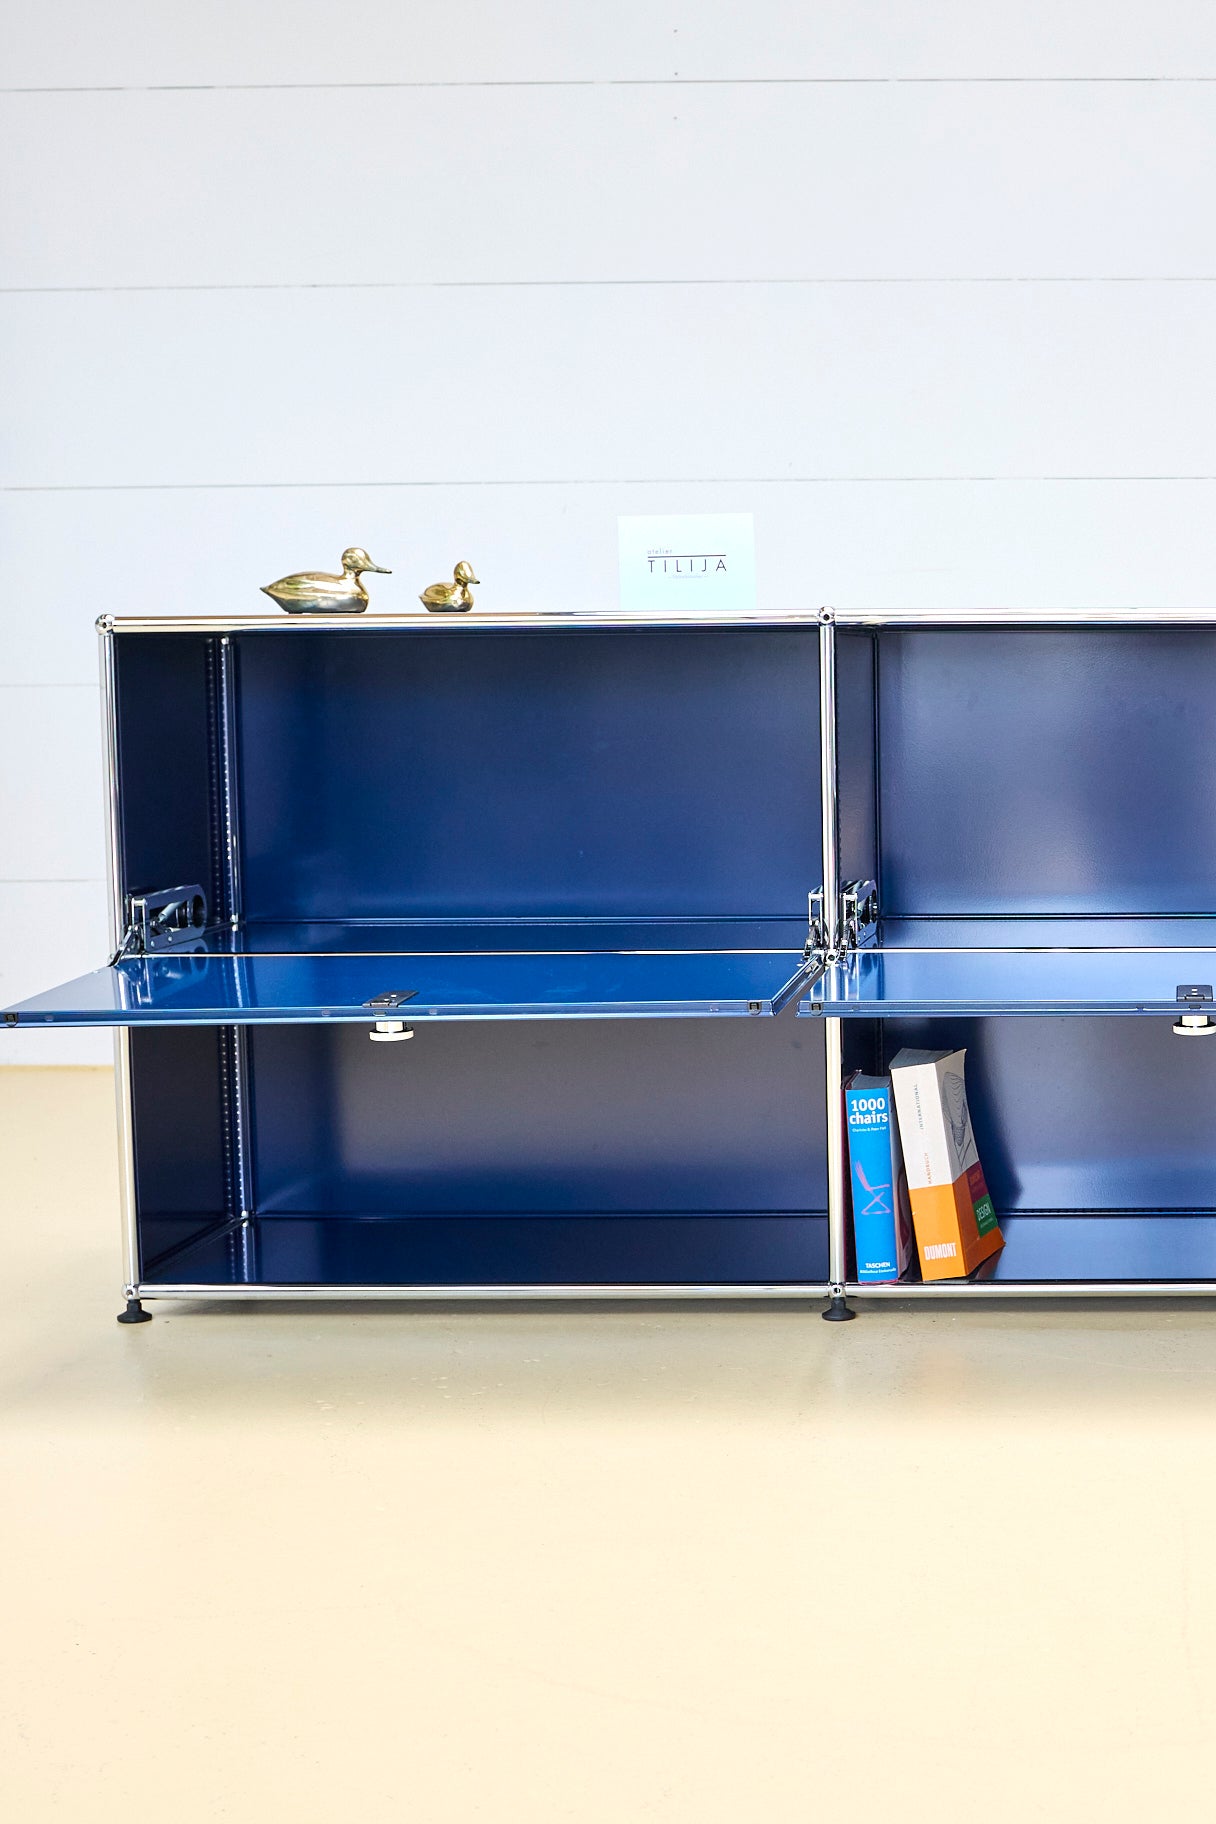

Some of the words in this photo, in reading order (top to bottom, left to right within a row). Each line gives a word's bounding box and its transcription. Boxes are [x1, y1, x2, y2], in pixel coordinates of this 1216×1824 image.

[647, 559, 727, 573] TILIJA
[851, 1097, 886, 1112] 1000
[849, 1110, 889, 1125] chairs
[923, 1242, 957, 1261] DUMONT
